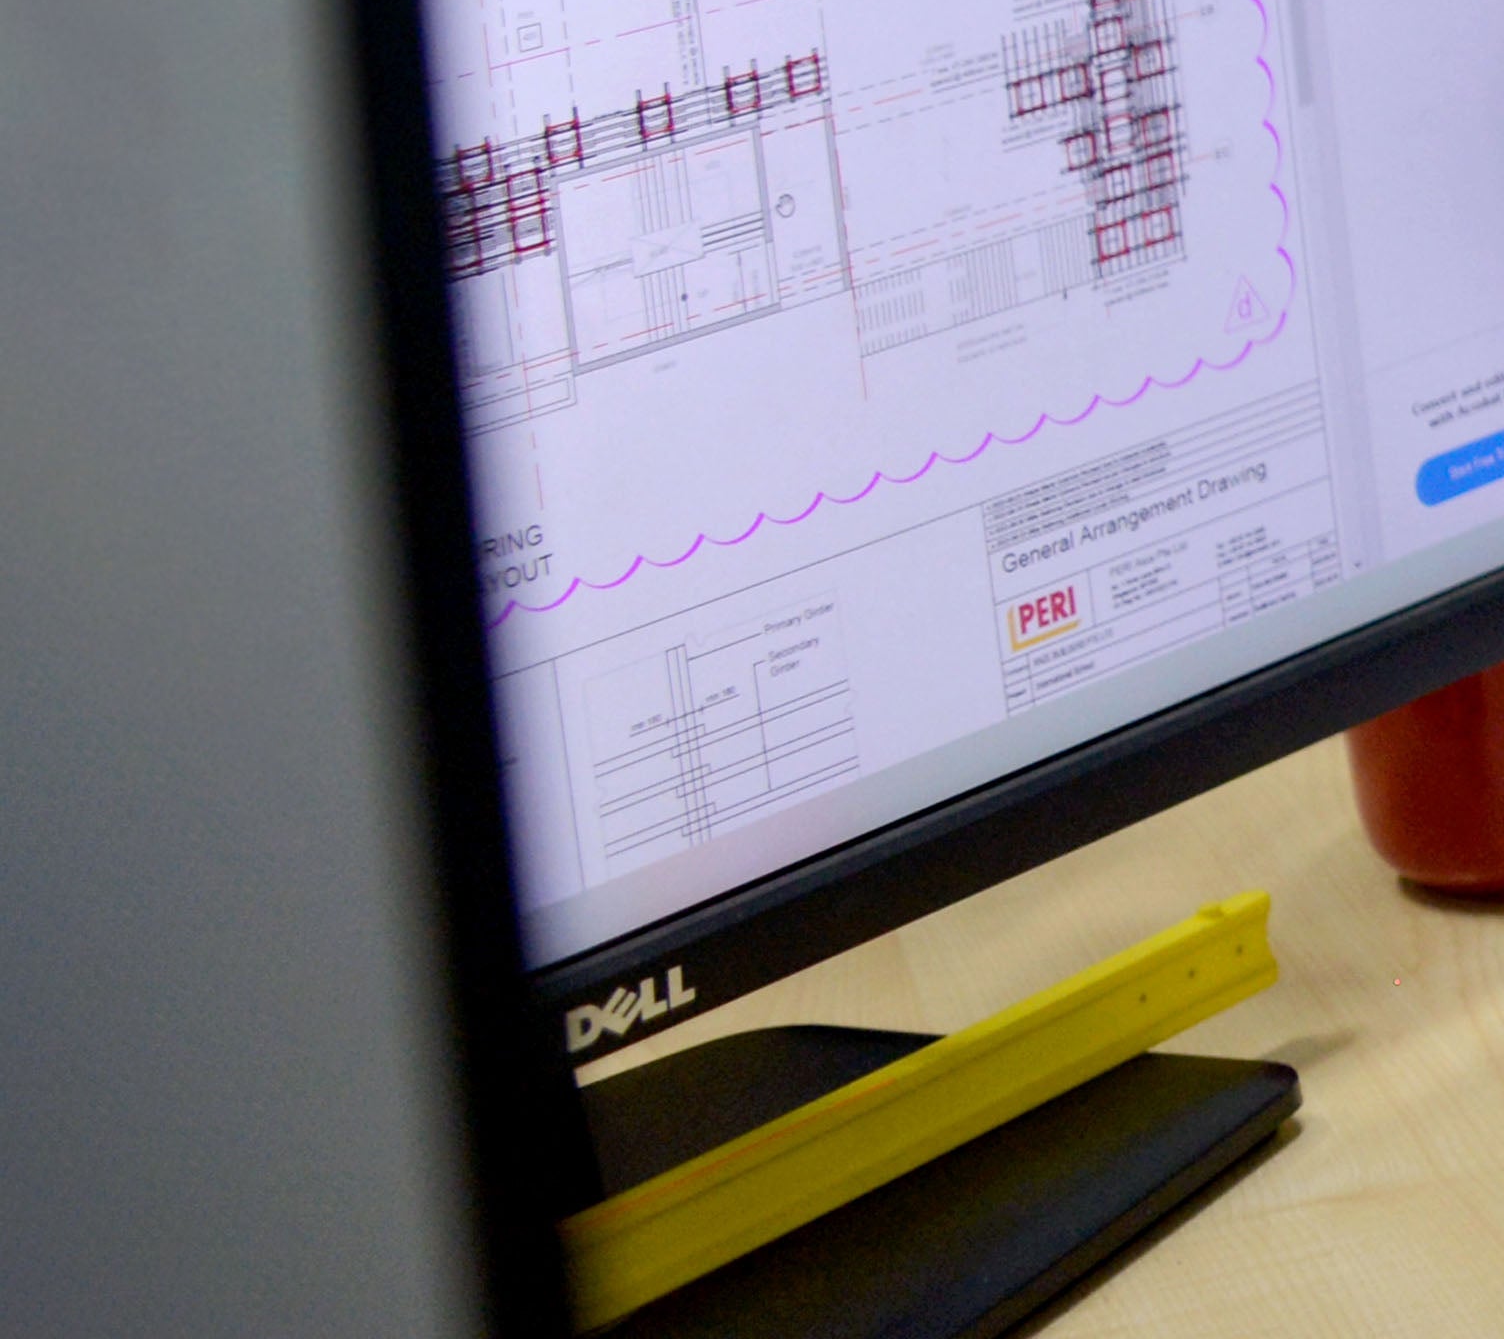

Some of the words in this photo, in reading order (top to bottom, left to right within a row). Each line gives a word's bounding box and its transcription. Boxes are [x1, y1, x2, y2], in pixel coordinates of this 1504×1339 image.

[1001, 530, 1075, 573] General
[1080, 488, 1194, 545] Arrangement
[1197, 461, 1267, 501] Drawing
[483, 525, 543, 557] RING
[487, 554, 553, 593] YOUT
[763, 615, 801, 635] Primary
[804, 602, 834, 620] Girder
[1018, 586, 1076, 635] PERI
[767, 636, 820, 662] Secondary
[564, 964, 697, 1053] DELL
